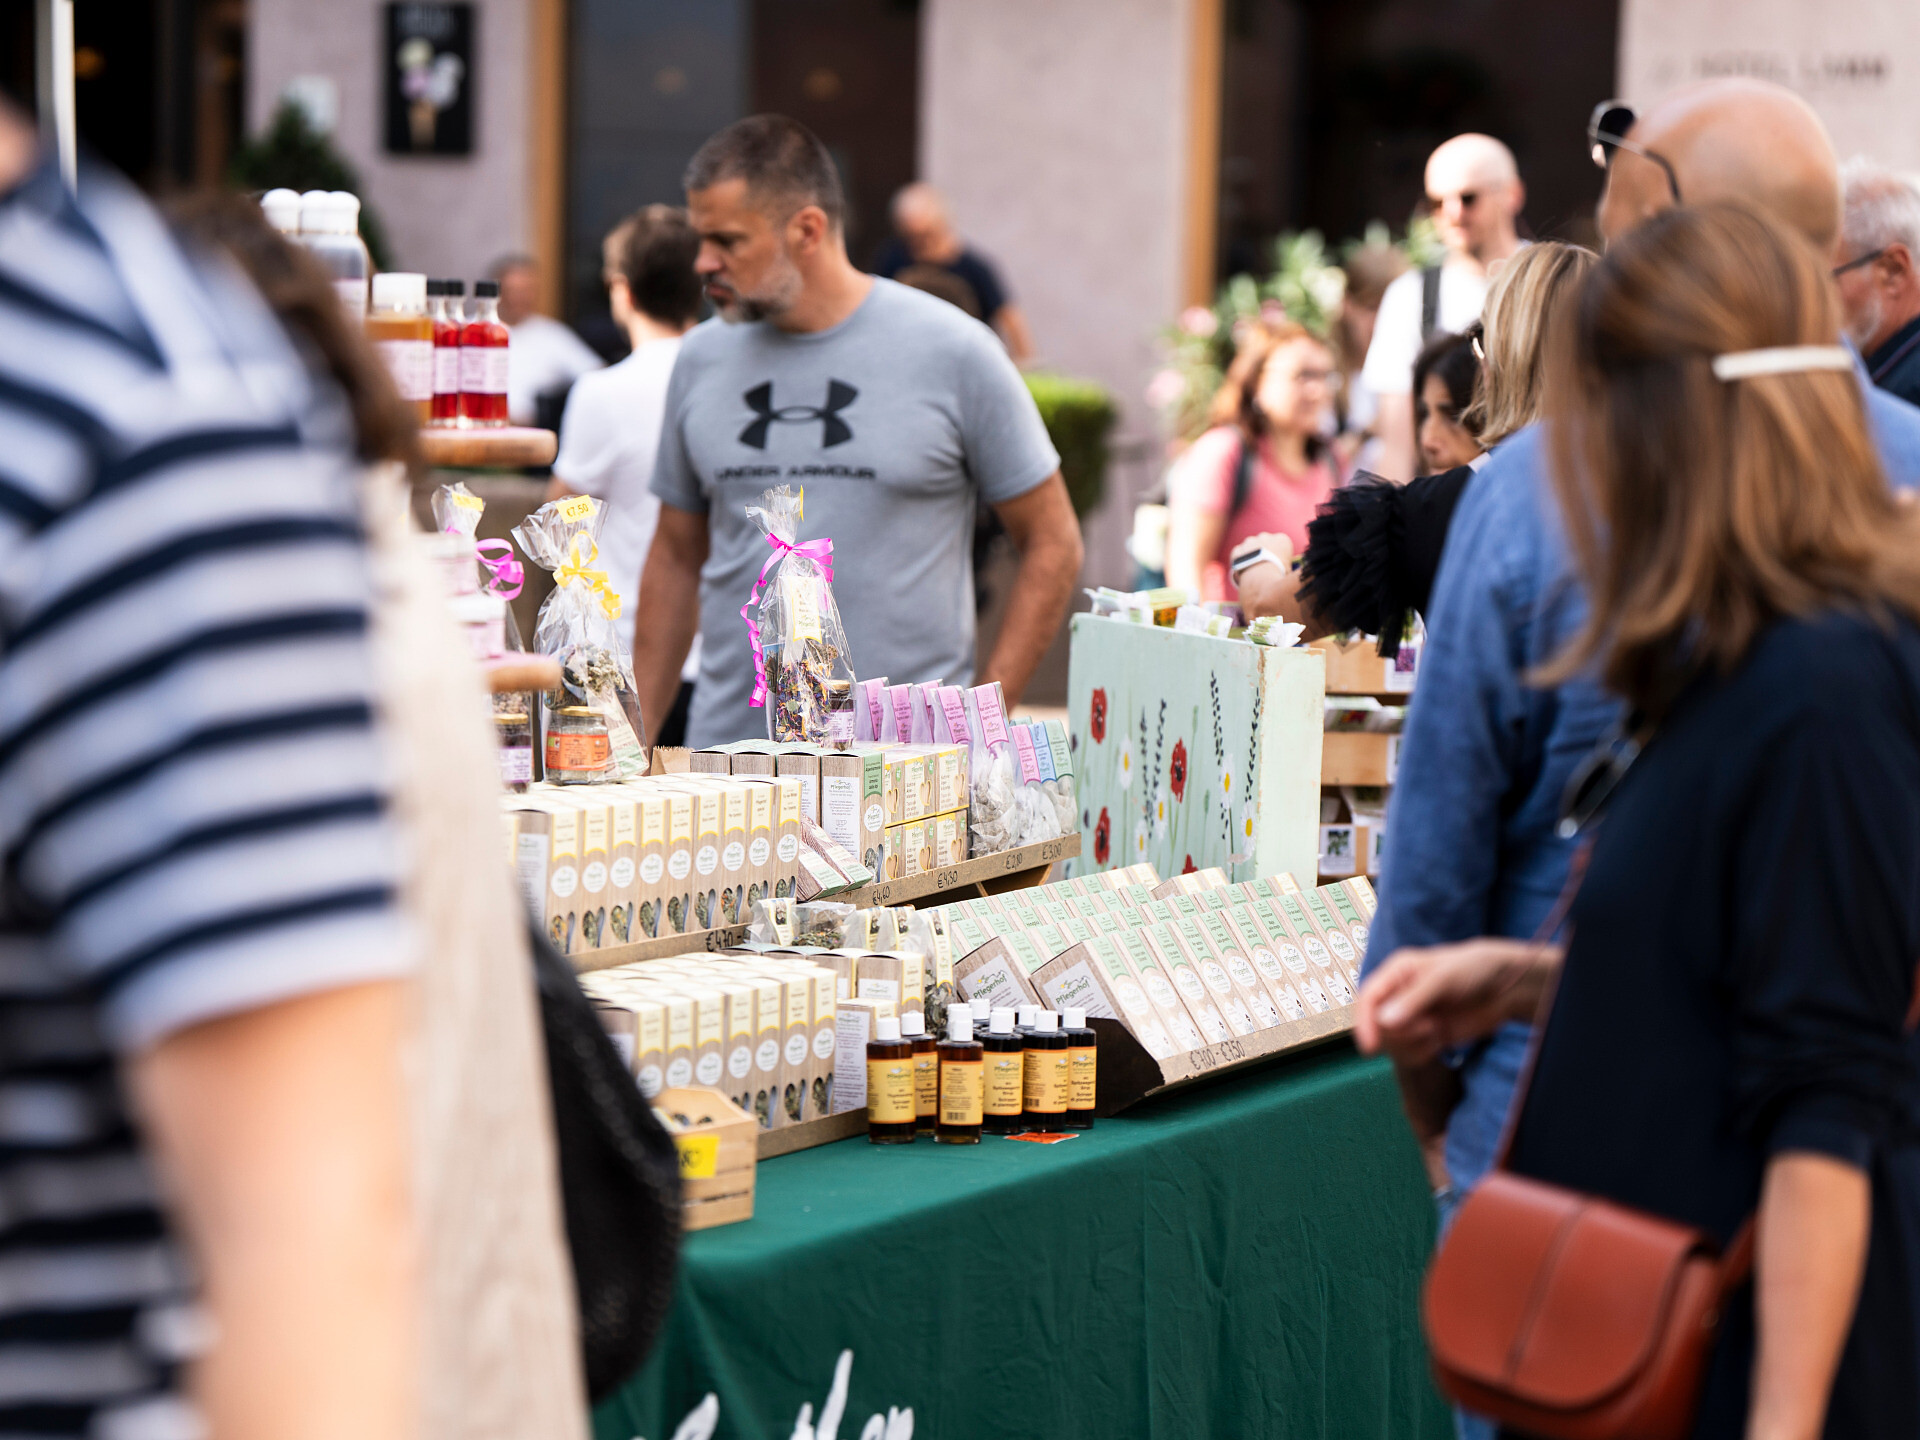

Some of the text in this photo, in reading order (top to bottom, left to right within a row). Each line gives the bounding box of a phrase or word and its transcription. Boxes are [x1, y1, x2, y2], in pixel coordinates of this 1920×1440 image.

[714, 464, 876, 481] UNDER ARMOUR
[973, 973, 1008, 999] Pflegerhof
[1055, 979, 1090, 1005] Pflegerhof
